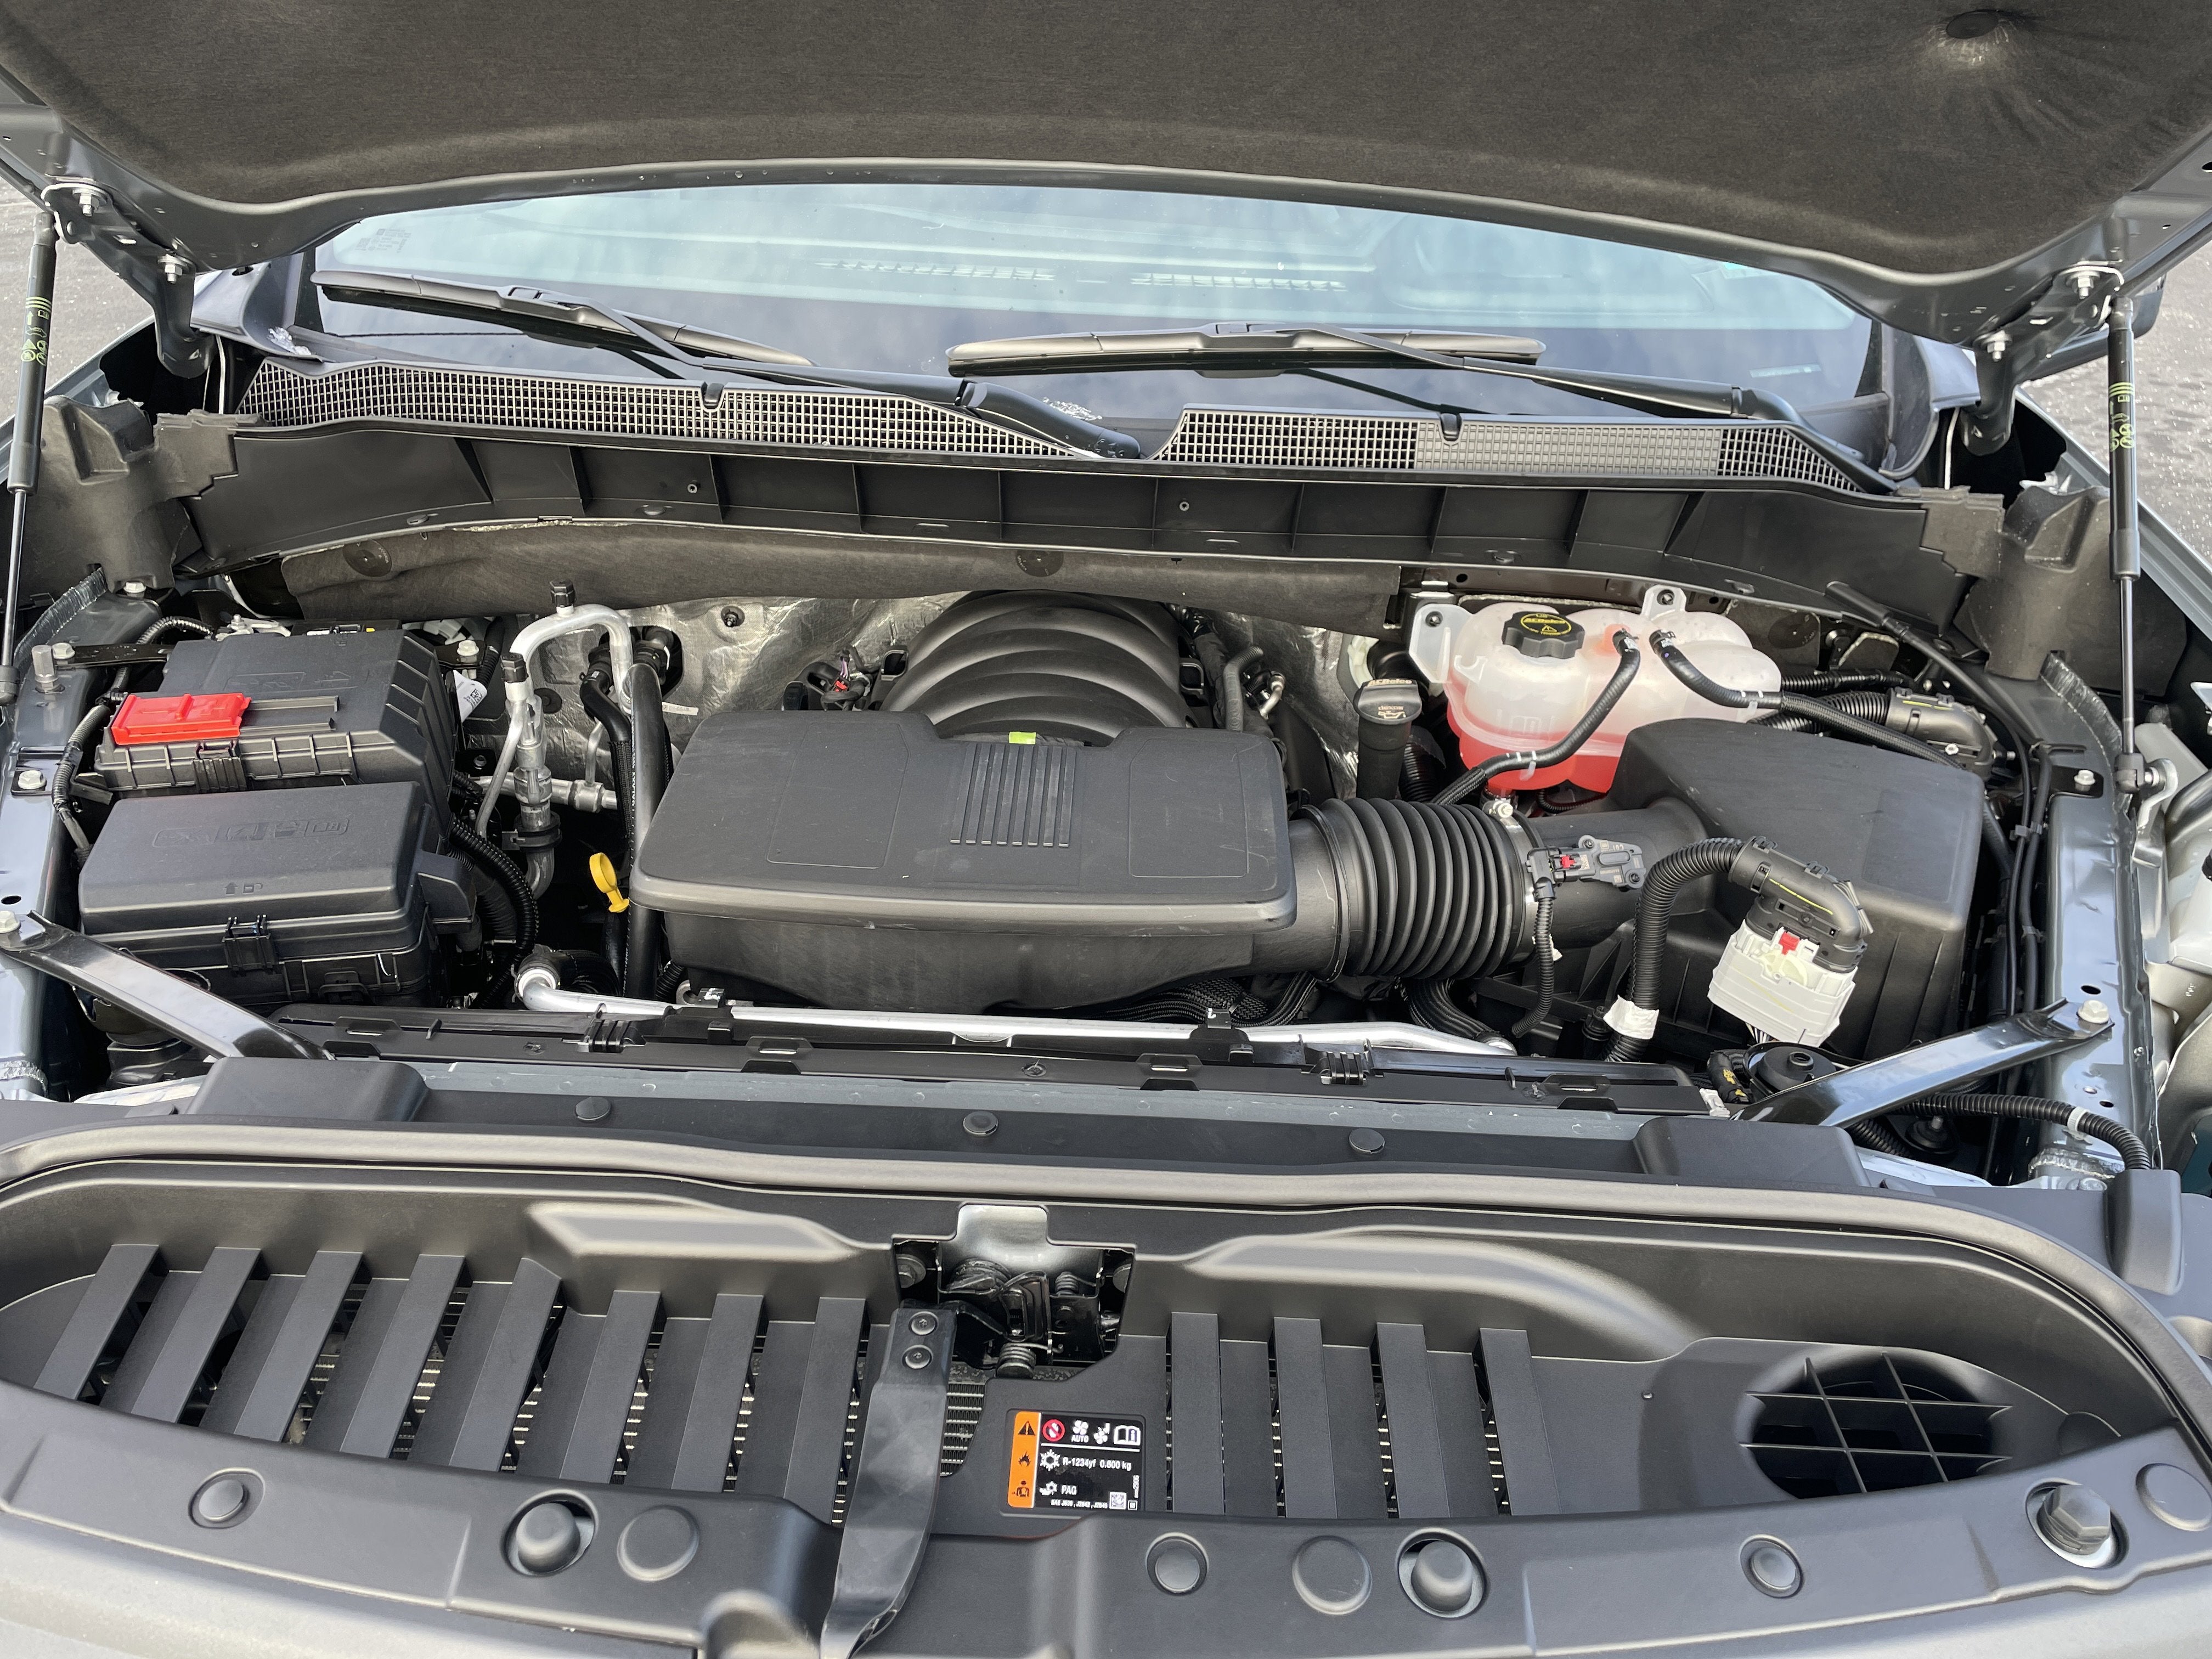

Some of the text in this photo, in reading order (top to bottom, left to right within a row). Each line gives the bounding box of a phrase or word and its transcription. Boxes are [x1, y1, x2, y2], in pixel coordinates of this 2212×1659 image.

[1367, 679, 1412, 687] ACDelco
[1071, 1435, 1089, 1443] AUTO
[1063, 1457, 1096, 1469] R-1234yf
[1122, 1461, 1132, 1471] kg
[1061, 1485, 1077, 1495] PAG
